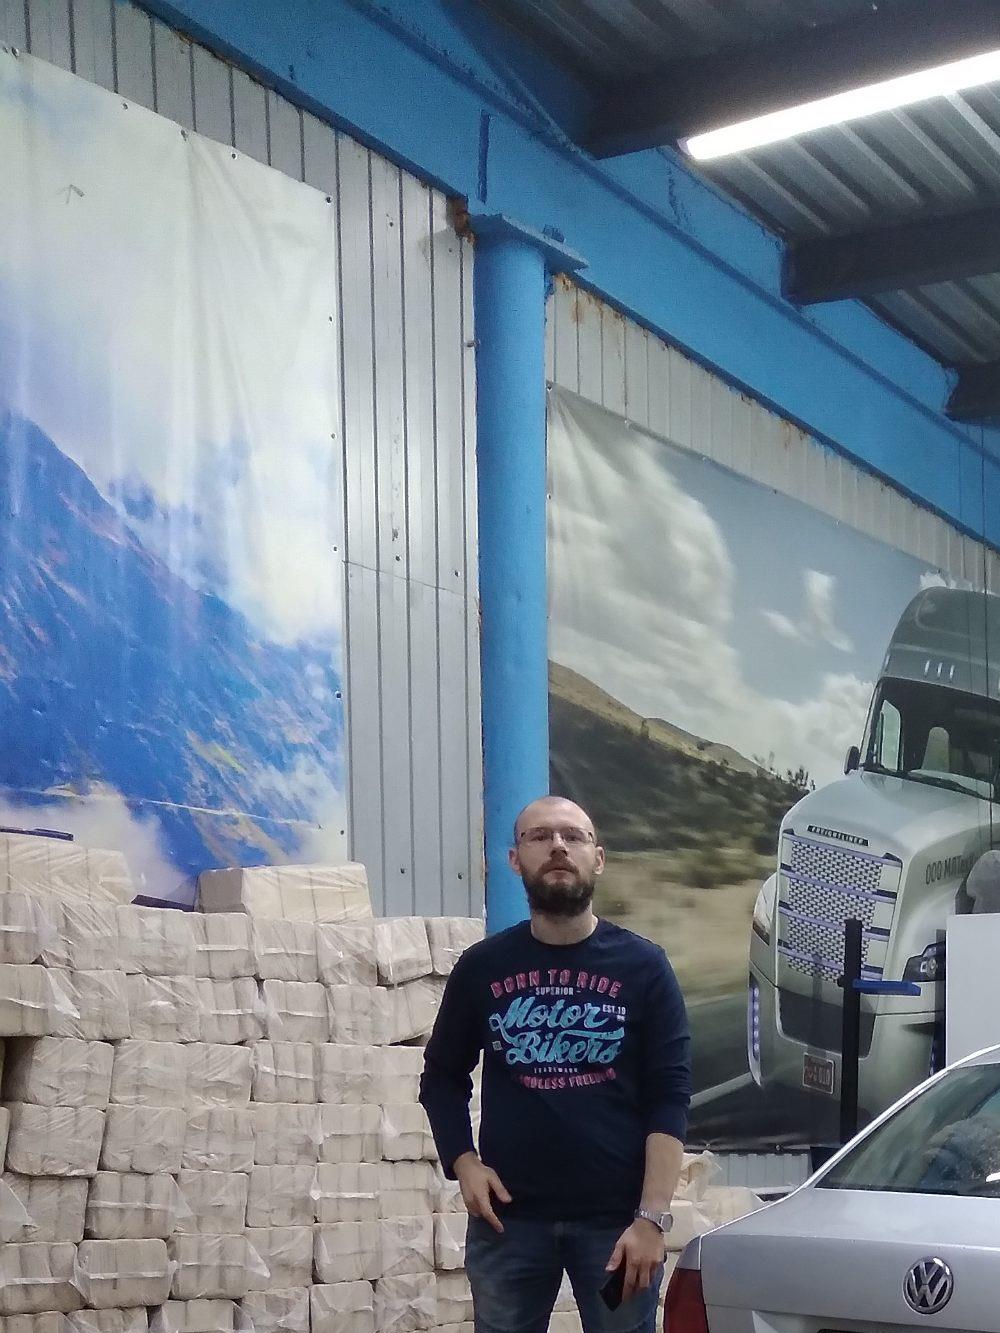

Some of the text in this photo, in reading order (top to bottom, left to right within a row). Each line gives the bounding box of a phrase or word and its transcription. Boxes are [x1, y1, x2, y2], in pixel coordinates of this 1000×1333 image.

[490, 969, 622, 999] BORN TO RIDE
[535, 986, 574, 996] SUPERIOR
[489, 996, 609, 1029] Motor
[506, 1030, 625, 1065] Bikers
